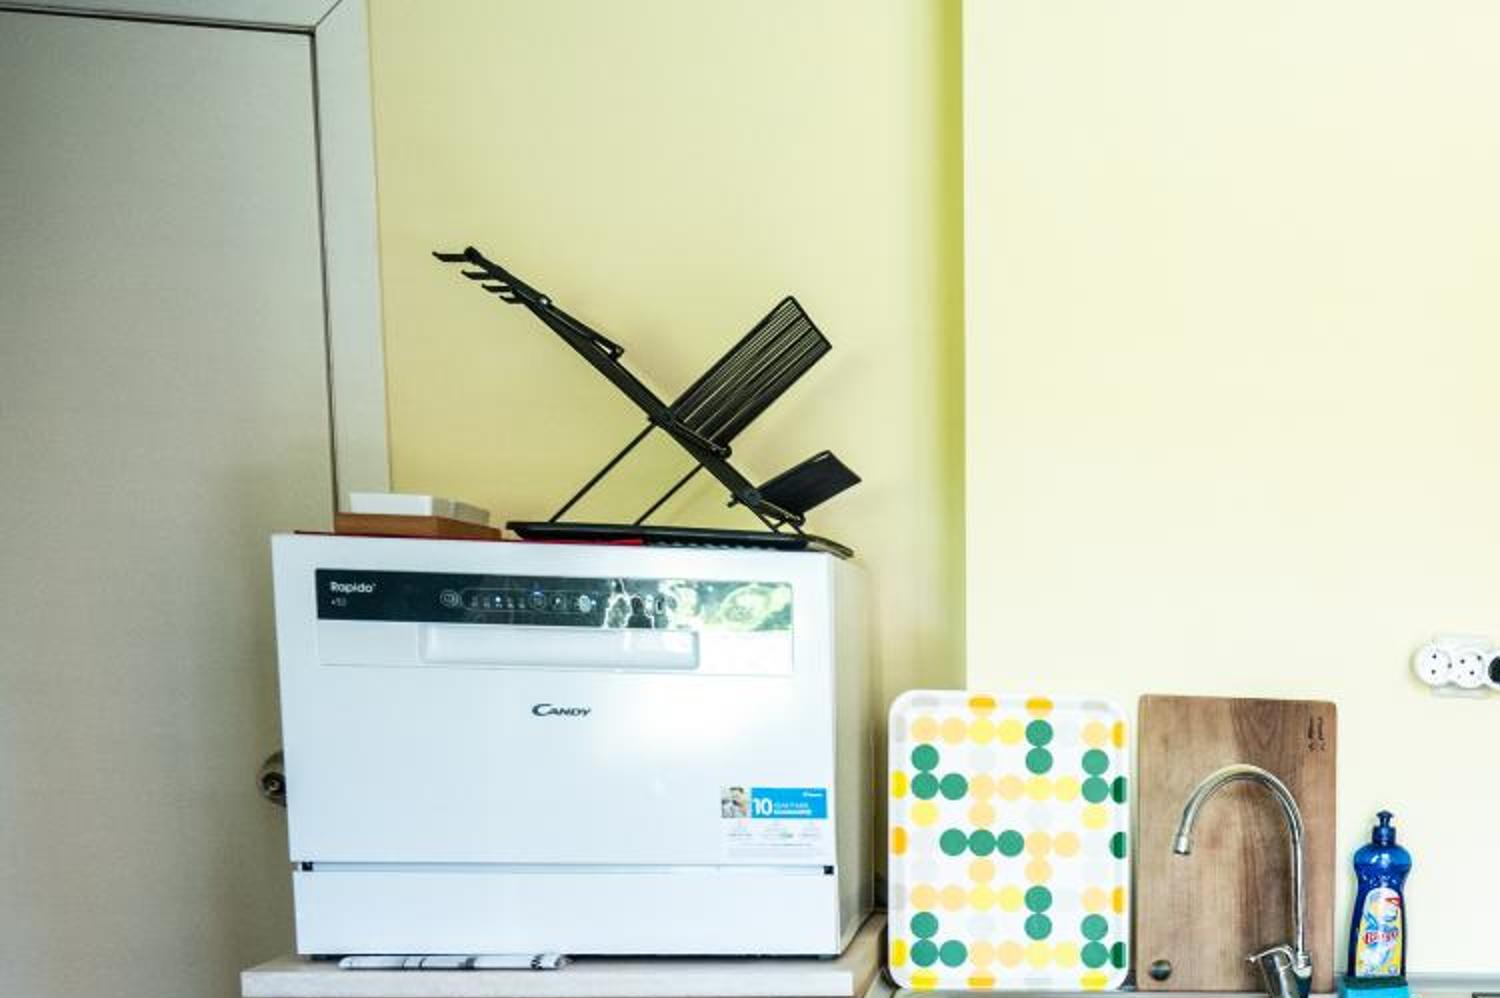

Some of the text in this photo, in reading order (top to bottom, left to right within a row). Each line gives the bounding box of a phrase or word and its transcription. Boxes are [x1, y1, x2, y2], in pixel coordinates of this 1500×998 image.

[330, 581, 374, 594] Rapido
[531, 703, 592, 717] CANDY
[753, 797, 773, 816] 10
